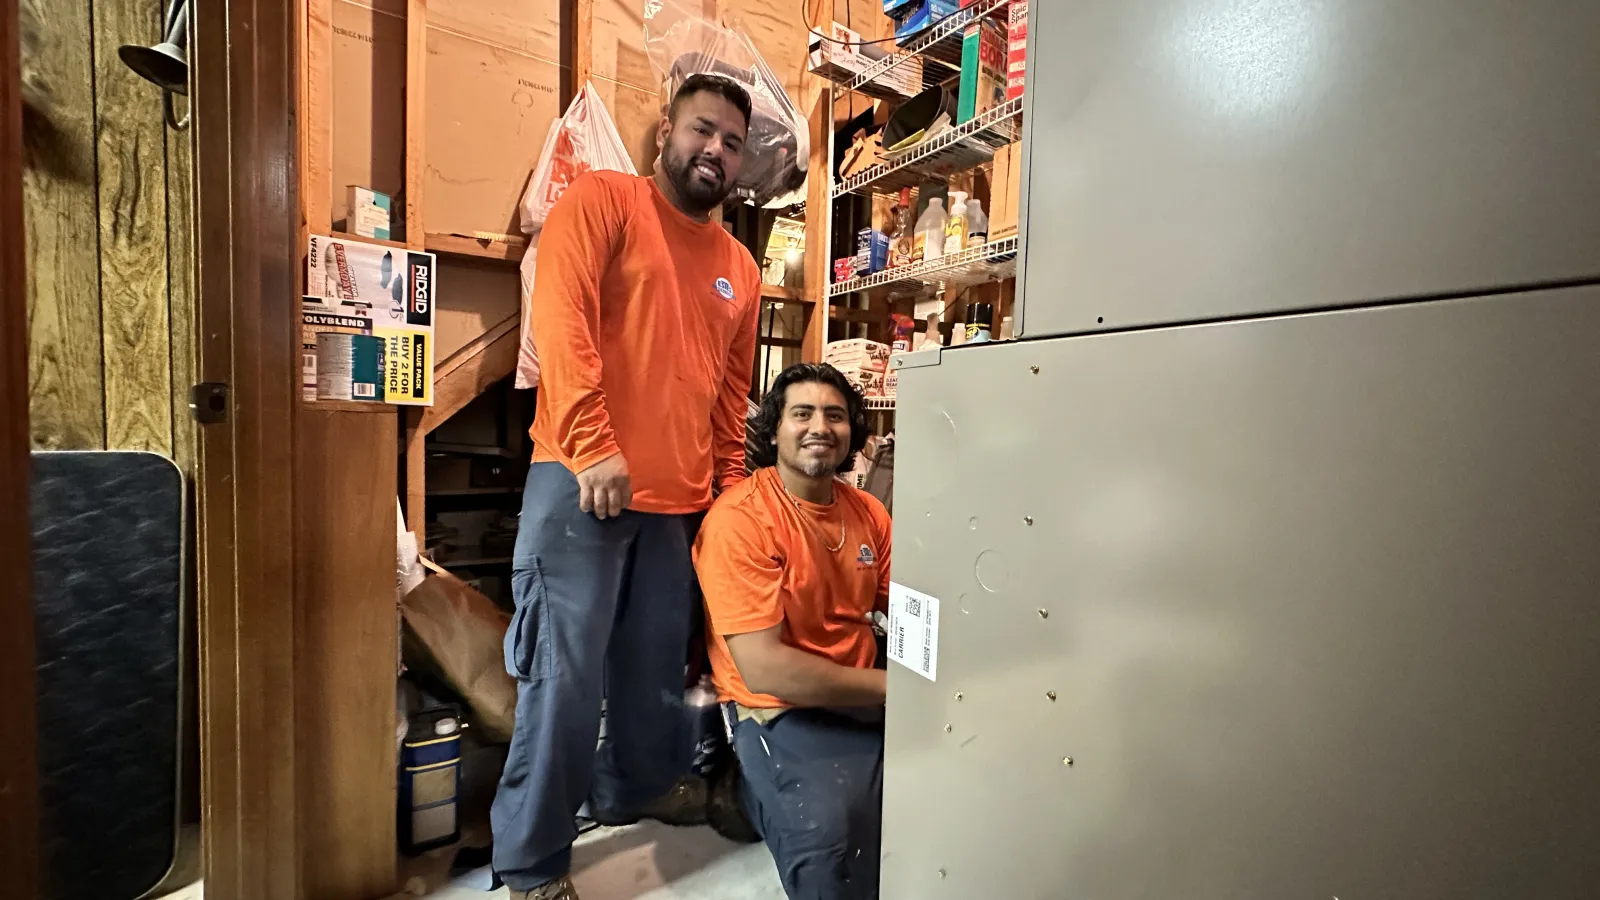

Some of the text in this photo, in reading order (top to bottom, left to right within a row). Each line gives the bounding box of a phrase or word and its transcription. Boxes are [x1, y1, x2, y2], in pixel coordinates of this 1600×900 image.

[1011, 5, 1027, 16] Spic
[334, 243, 352, 294] EVERYDAY
[416, 265, 427, 314] RIDGID
[390, 335, 398, 394] THE PRICE
[401, 336, 409, 360] BUY
[401, 372, 409, 394] FOR
